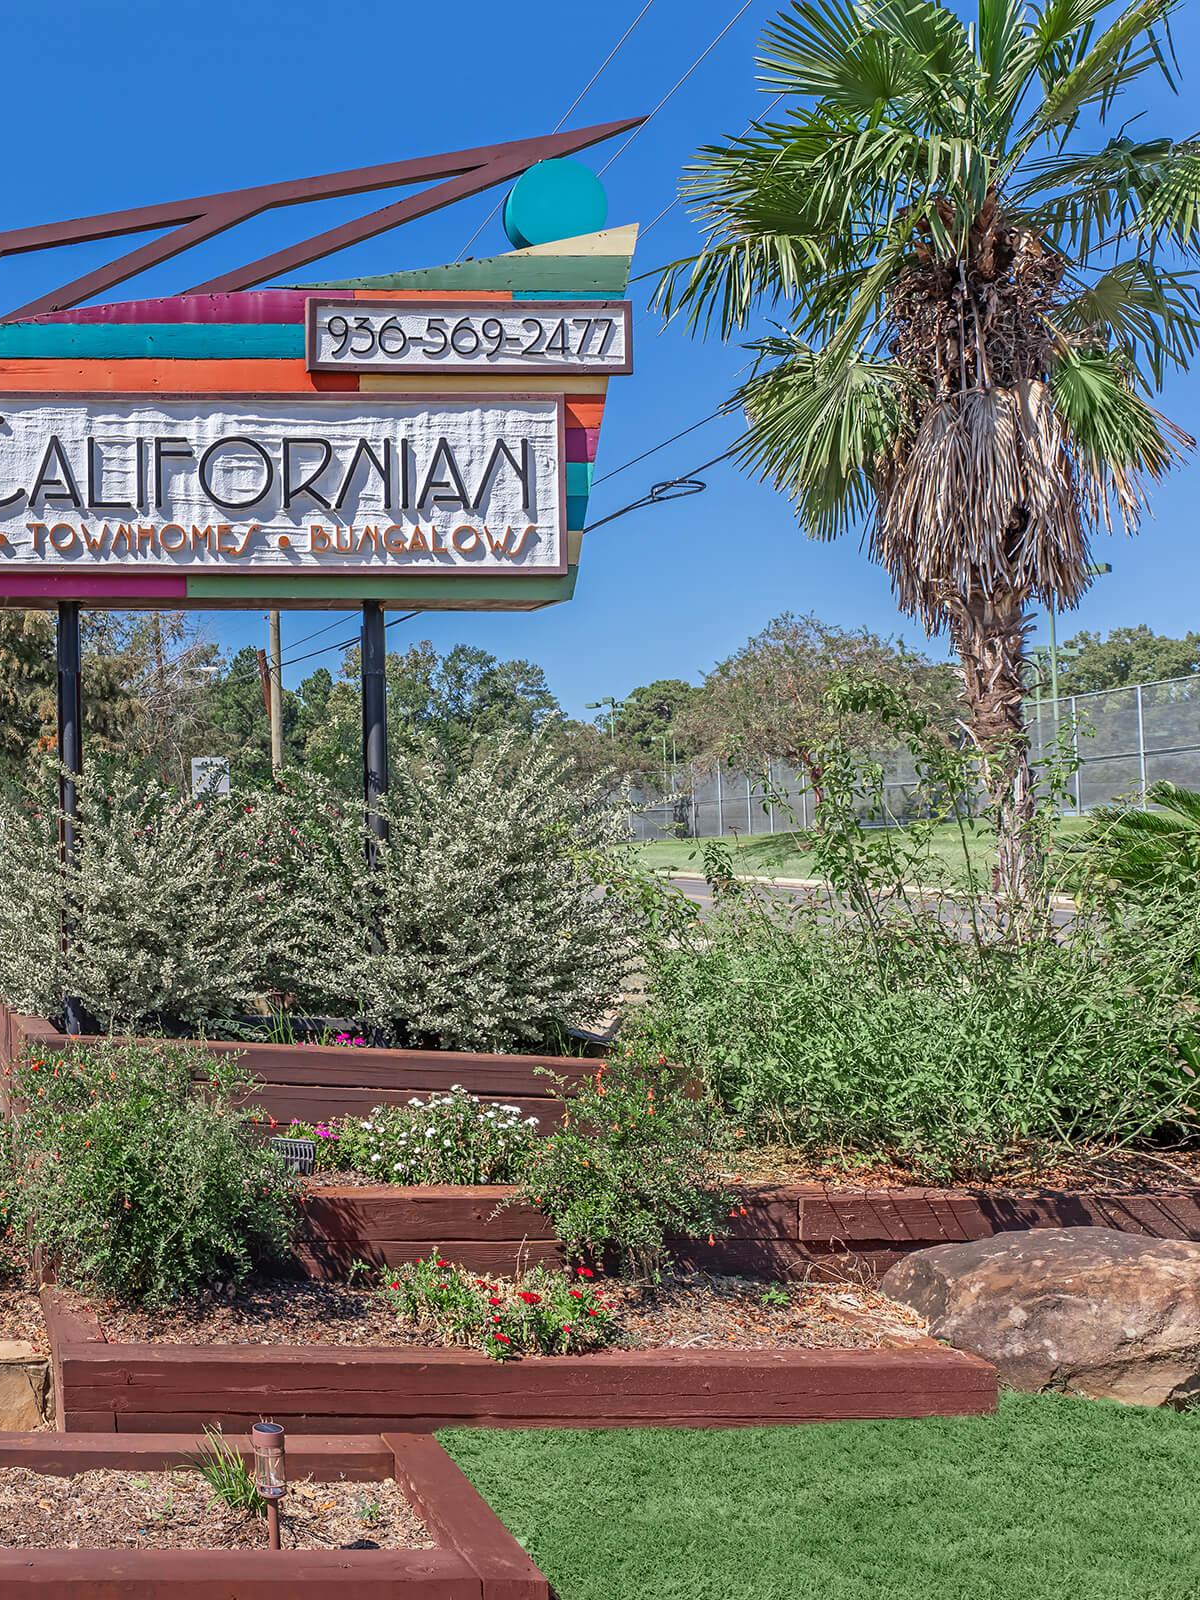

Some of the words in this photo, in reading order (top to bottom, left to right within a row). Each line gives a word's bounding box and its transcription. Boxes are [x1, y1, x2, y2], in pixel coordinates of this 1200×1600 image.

[327, 316, 613, 356] 936-569-2477
[26, 522, 260, 556] TOWNHOMES
[310, 524, 538, 557] BUNGALOWS
